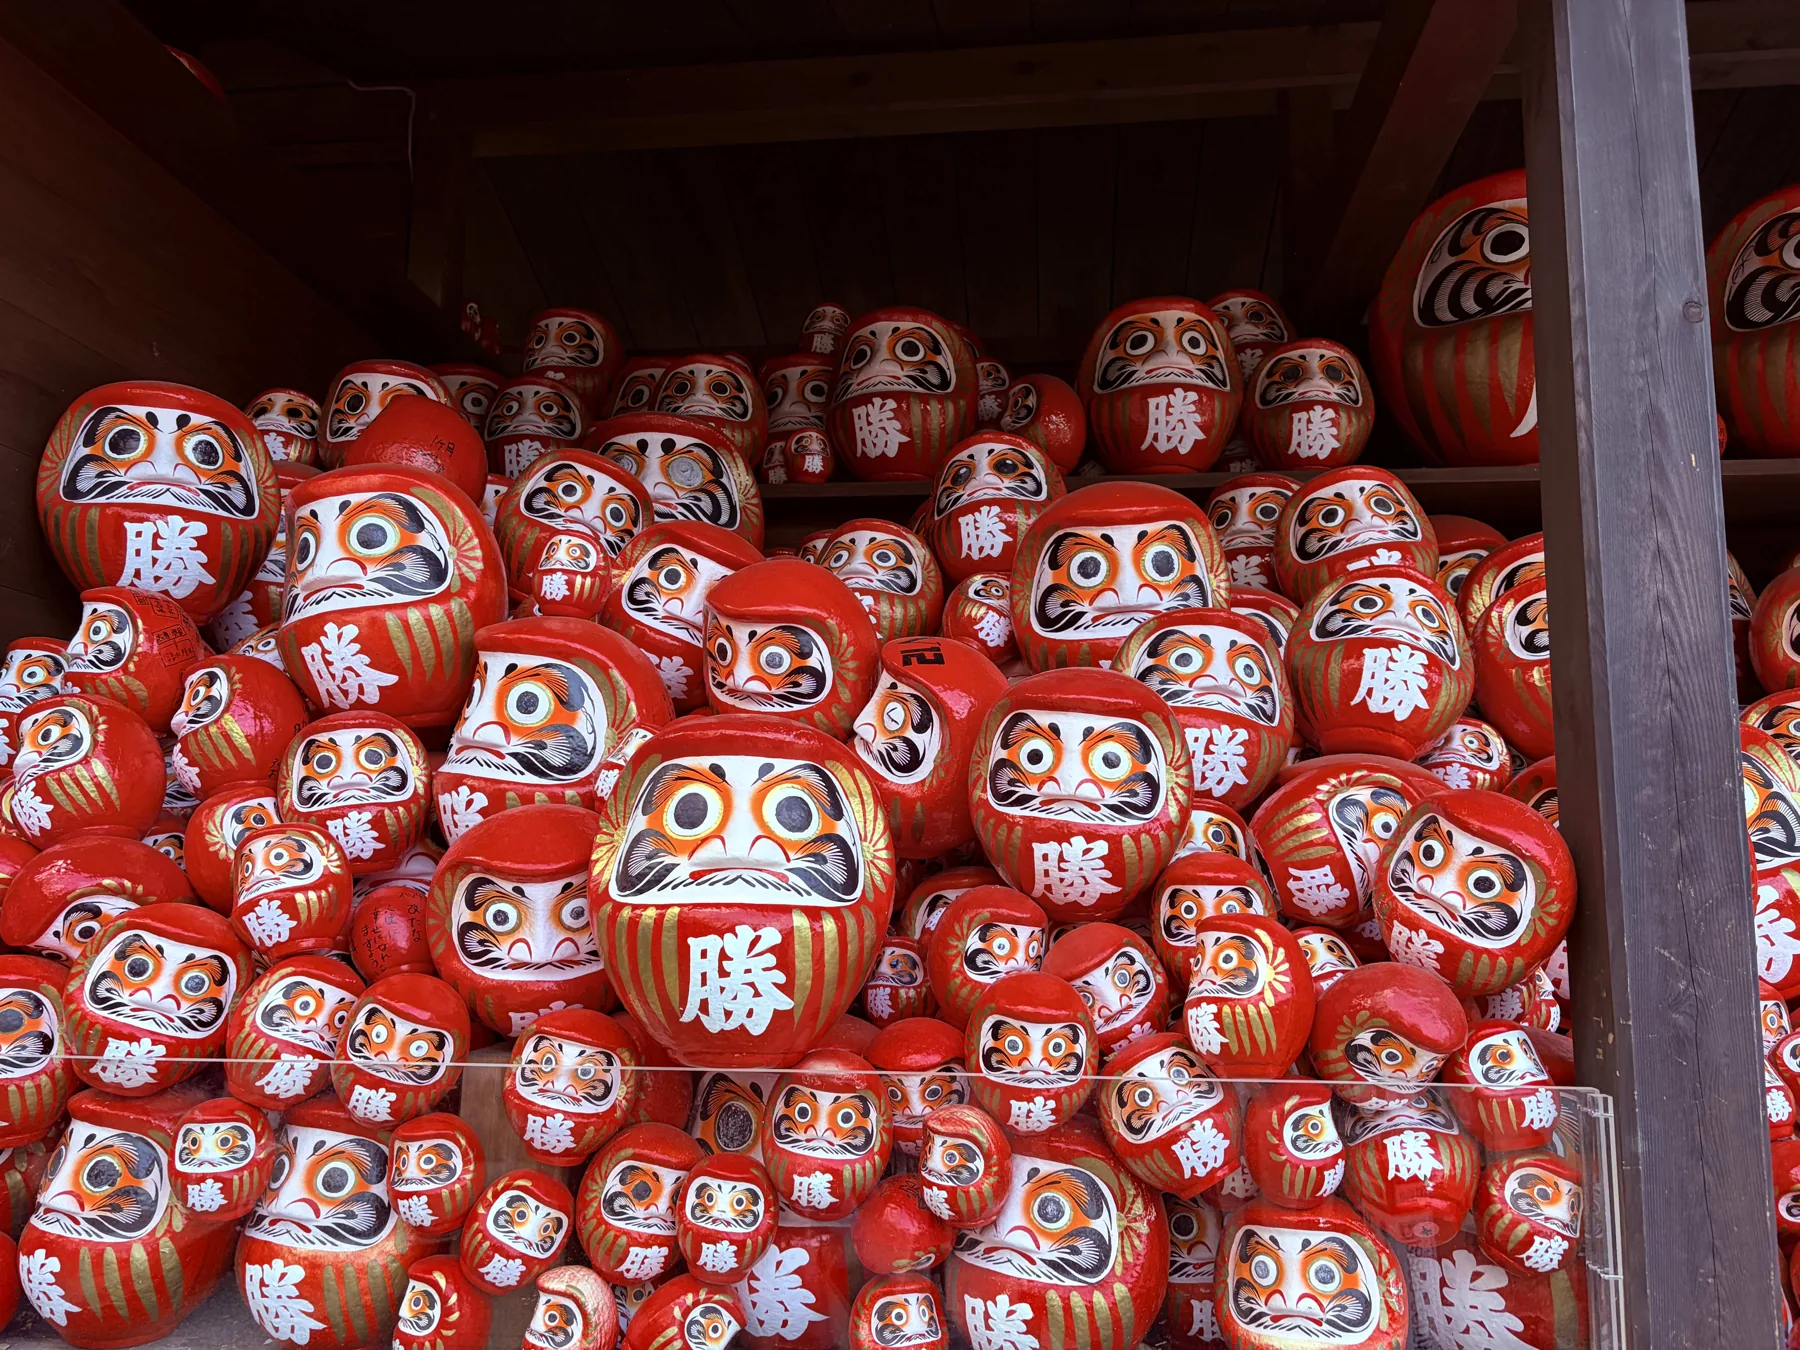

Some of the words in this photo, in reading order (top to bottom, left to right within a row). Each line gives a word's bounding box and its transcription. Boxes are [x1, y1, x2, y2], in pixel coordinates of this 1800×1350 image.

[811, 333, 835, 354] 勝
[852, 397, 911, 459] 勝
[1141, 388, 1206, 455] 勝
[1287, 405, 1341, 460] 勝
[803, 454, 824, 474] 勝
[117, 514, 217, 599] 勝
[958, 505, 1013, 561] 勝
[541, 571, 571, 601] 勝
[973, 609, 1012, 648] 勝
[301, 621, 399, 709] 勝
[1351, 644, 1430, 721] 勝
[1184, 724, 1249, 798] 勝
[11, 780, 54, 838] 勝
[326, 810, 386, 860] 勝
[1031, 835, 1123, 906] 勝
[1287, 865, 1350, 917] 勝
[242, 898, 297, 947] 勝
[1390, 920, 1445, 972] 勝
[679, 925, 795, 1036] 勝
[867, 987, 896, 1020] 勝
[1485, 988, 1523, 1020] 勝
[1188, 1002, 1229, 1055] 勝
[91, 1037, 166, 1089] 勝
[255, 1053, 319, 1099] 勝
[348, 1084, 397, 1122] 勝
[1008, 1096, 1060, 1133] 勝
[1521, 1087, 1558, 1130] 勝
[523, 1113, 577, 1154] 勝
[1172, 1118, 1230, 1179] 勝
[1383, 1130, 1444, 1183] 勝
[186, 1178, 228, 1212] 勝
[790, 1170, 839, 1209] 勝
[1315, 1159, 1346, 1198] 勝
[397, 1194, 439, 1228] 勝
[923, 1186, 956, 1221] 勝
[478, 1253, 527, 1288] 勝
[614, 1245, 669, 1281] 勝
[696, 1240, 740, 1274] 勝
[1515, 1235, 1569, 1273] 勝
[18, 1249, 82, 1327] 勝
[245, 1258, 328, 1346] 勝
